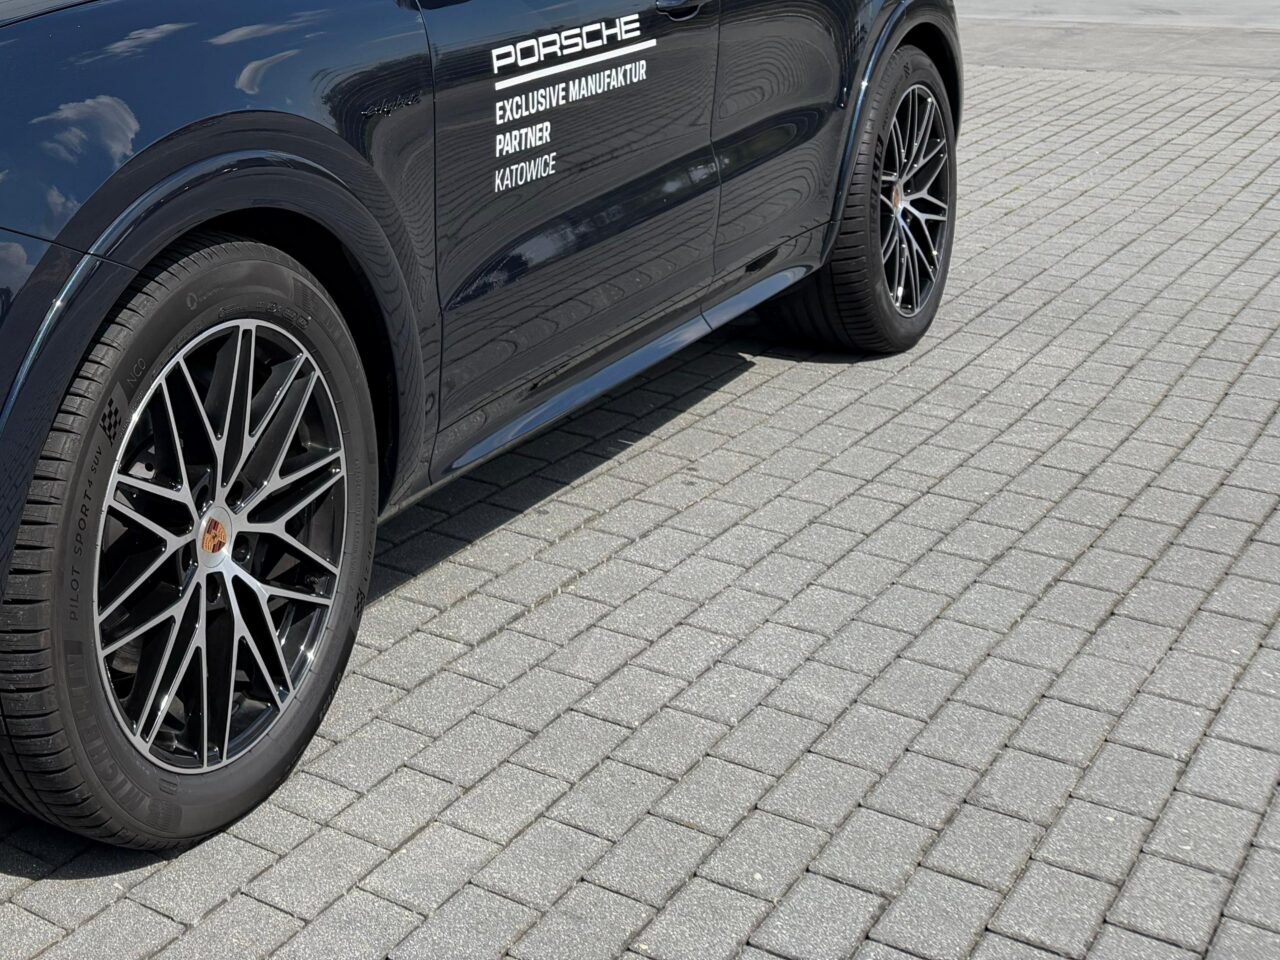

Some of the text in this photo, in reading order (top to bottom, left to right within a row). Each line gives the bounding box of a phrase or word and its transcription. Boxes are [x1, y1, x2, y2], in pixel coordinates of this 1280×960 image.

[491, 13, 641, 74] PORSCHE
[495, 59, 647, 125] EXCLUSIVE MANUFAKTUR
[495, 121, 551, 157] PARTNER
[494, 152, 557, 192] KATOWICE
[73, 489, 93, 557] SPORT
[70, 565, 81, 622] PILOT
